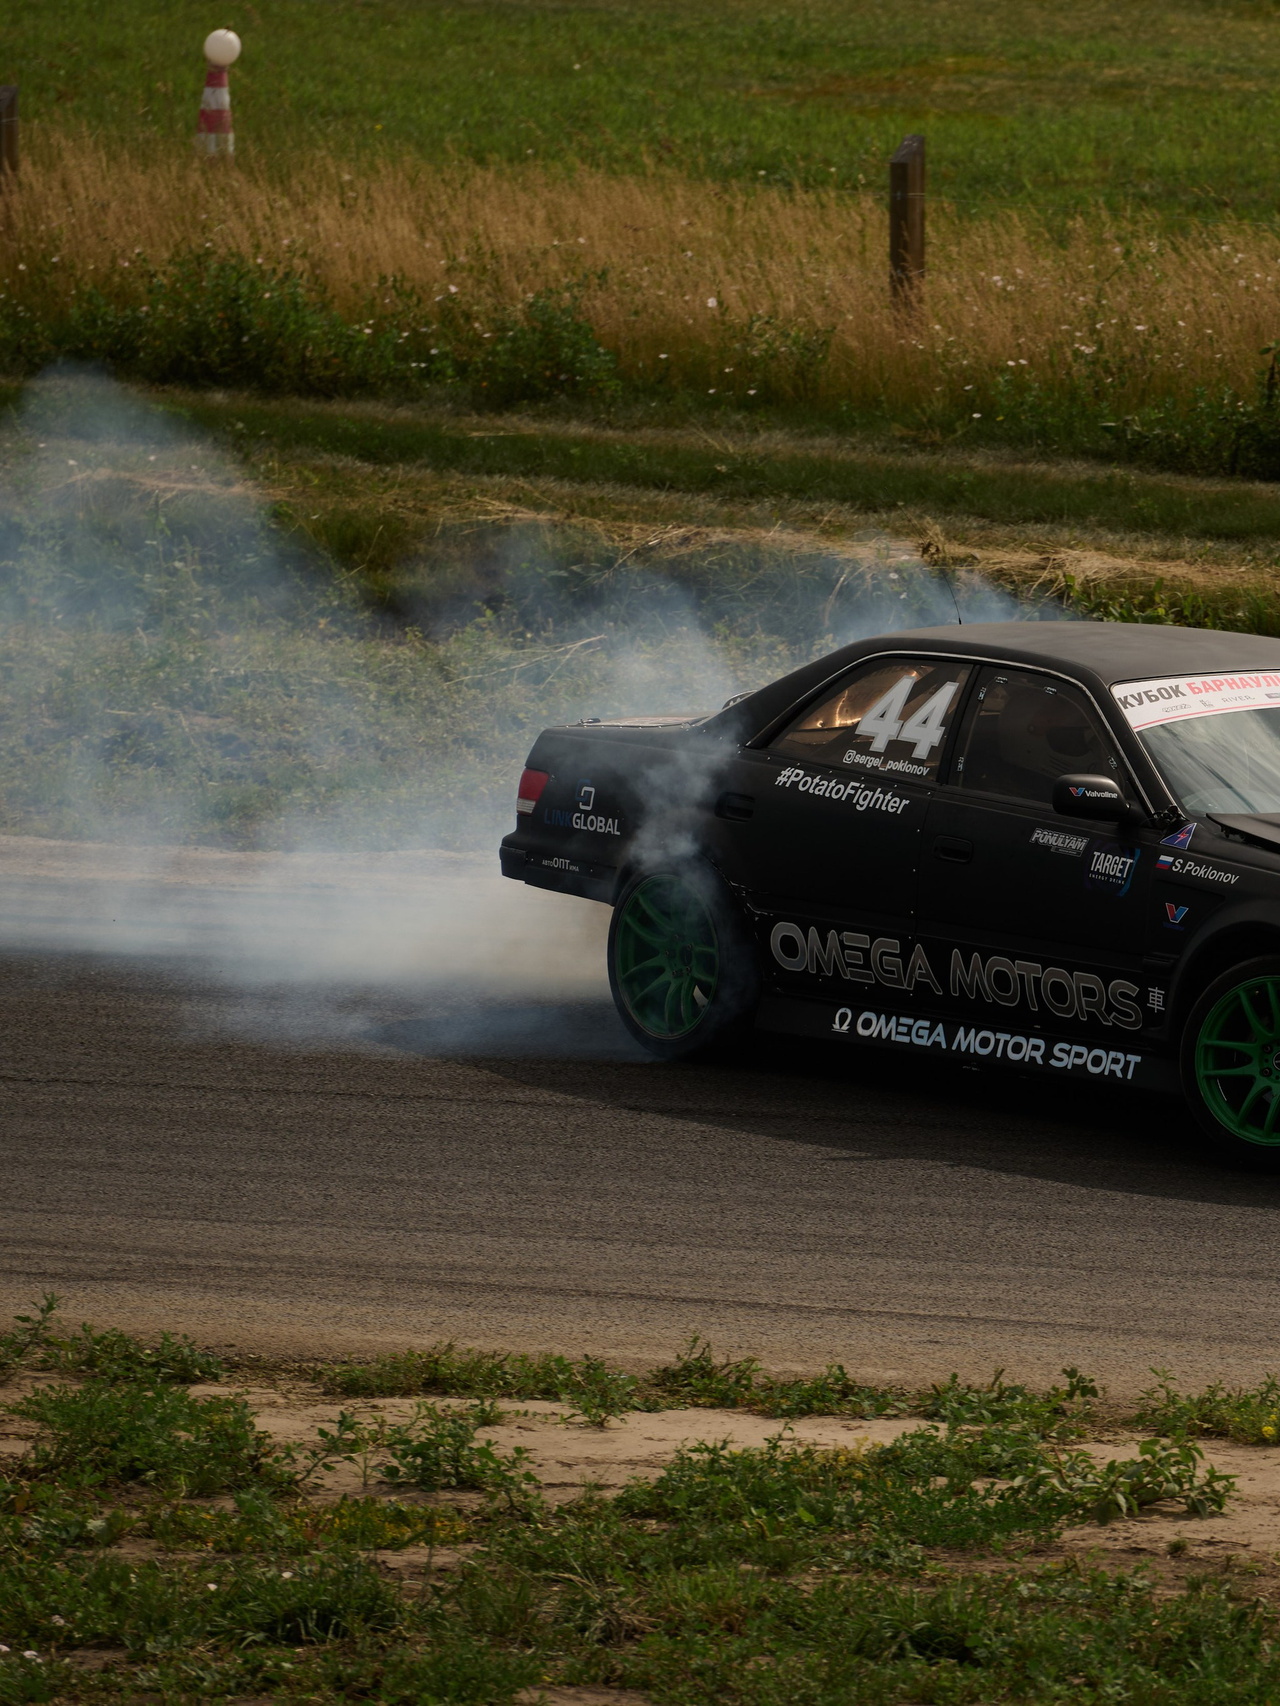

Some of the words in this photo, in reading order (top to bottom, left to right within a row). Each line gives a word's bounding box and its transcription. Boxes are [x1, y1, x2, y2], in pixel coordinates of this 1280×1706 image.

[1116, 684, 1187, 710] КУБОК
[855, 674, 960, 760] 44
[775, 767, 910, 814] #PotatoFighter
[1085, 790, 1118, 799] Valvoline
[1090, 851, 1134, 878] TARGET
[1171, 858, 1240, 885] S.Poklonov
[770, 921, 943, 995] OMEGA
[950, 948, 1143, 1030] MOTORS
[856, 1011, 947, 1049] OMEGA
[951, 1026, 1044, 1065] MOTOR
[1048, 1042, 1142, 1080] SPORT
